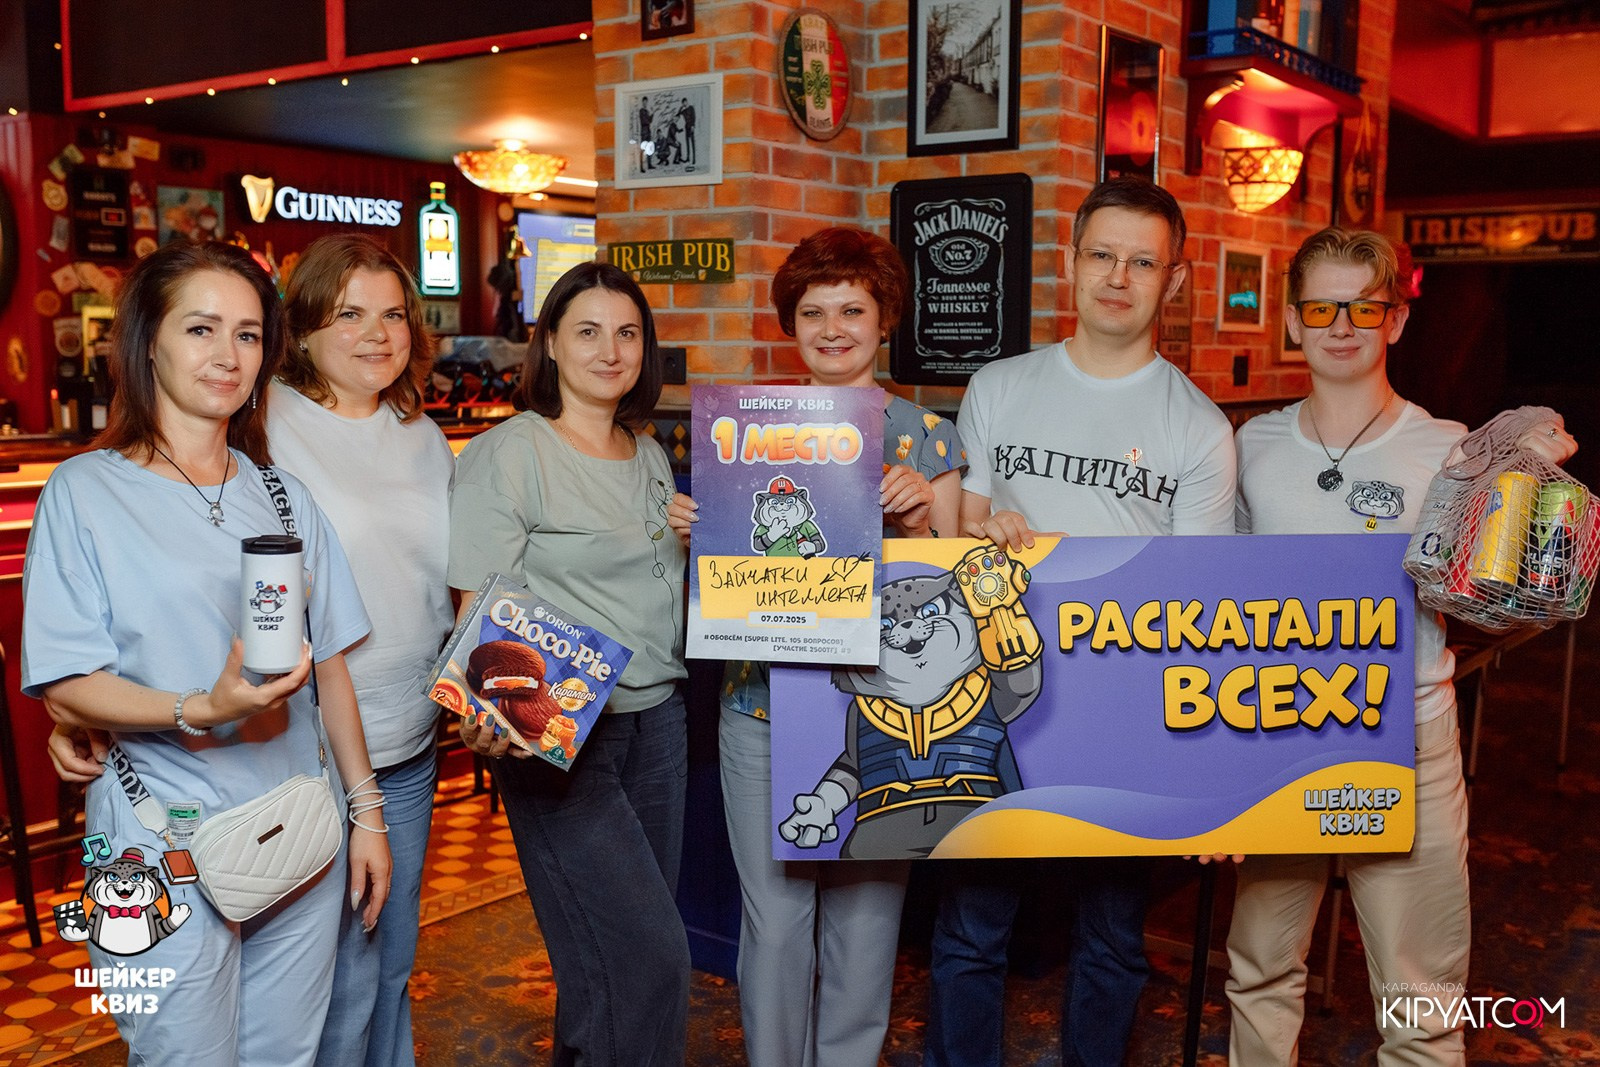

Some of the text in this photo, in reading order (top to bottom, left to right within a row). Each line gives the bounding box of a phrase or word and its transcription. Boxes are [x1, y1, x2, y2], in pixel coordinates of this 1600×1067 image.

[275, 186, 403, 227] GUINNESS
[913, 204, 1009, 246] JACK DANIEL'S
[612, 243, 673, 272] IRISH
[683, 242, 731, 272] PUB
[927, 278, 991, 293] Tennessee
[927, 302, 989, 313] WHISKEY
[739, 396, 834, 411] ШЕЙКЕР КВИЗ
[713, 418, 862, 464] 1 МЕСТО
[993, 444, 1179, 507] КАПИТАН
[252, 614, 285, 624] ШЕЙКЕР
[546, 613, 582, 640] ORION
[761, 615, 806, 624] 07.07.2025
[1058, 598, 1397, 653] РАСКАТАЛИ
[548, 681, 597, 702] Карамель
[1163, 663, 1390, 732] ВСЕХ!
[1304, 784, 1401, 812] ШЕЙКЕР
[1319, 812, 1386, 836] КВИЗ
